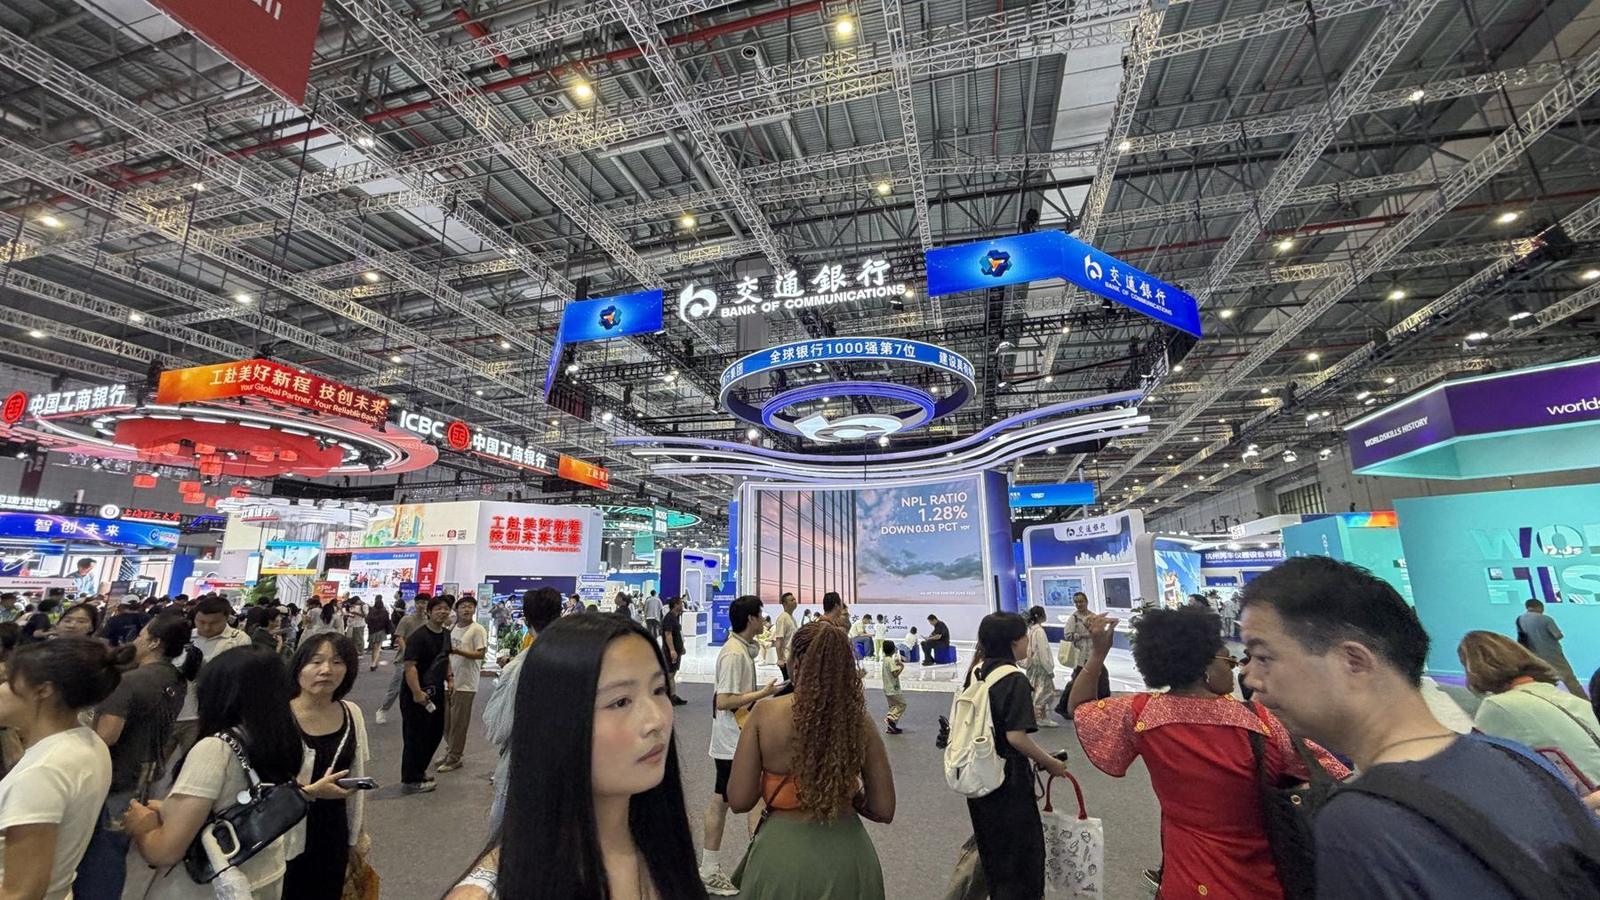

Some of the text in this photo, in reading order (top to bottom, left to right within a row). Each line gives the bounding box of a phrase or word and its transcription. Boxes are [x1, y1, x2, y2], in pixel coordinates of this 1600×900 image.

[735, 259, 891, 304] 交通銀行
[721, 284, 907, 318] BANK OF COMMUNICATIONS
[1104, 281, 1120, 293] BANK
[1130, 293, 1173, 316] COMMUNICATIONS
[769, 341, 917, 364] 全球银行1000强第7位
[28, 384, 126, 416] 中国工商银行
[209, 364, 387, 415] 工赴美好新程 技创未来
[240, 384, 379, 423] Your Global Partner Your Reliable Bank
[1546, 396, 1600, 415] world
[399, 410, 445, 438] ICBC
[1364, 416, 1428, 447] WORLDSKILLS HISTORY
[473, 433, 547, 469] 中国工商银行
[901, 491, 968, 507] NPL RATIO
[918, 504, 968, 522] 1.28%
[34, 518, 120, 537] 智创未来
[881, 525, 914, 535] DOWN
[915, 524, 935, 533] 0.03
[938, 522, 958, 532] PCT
